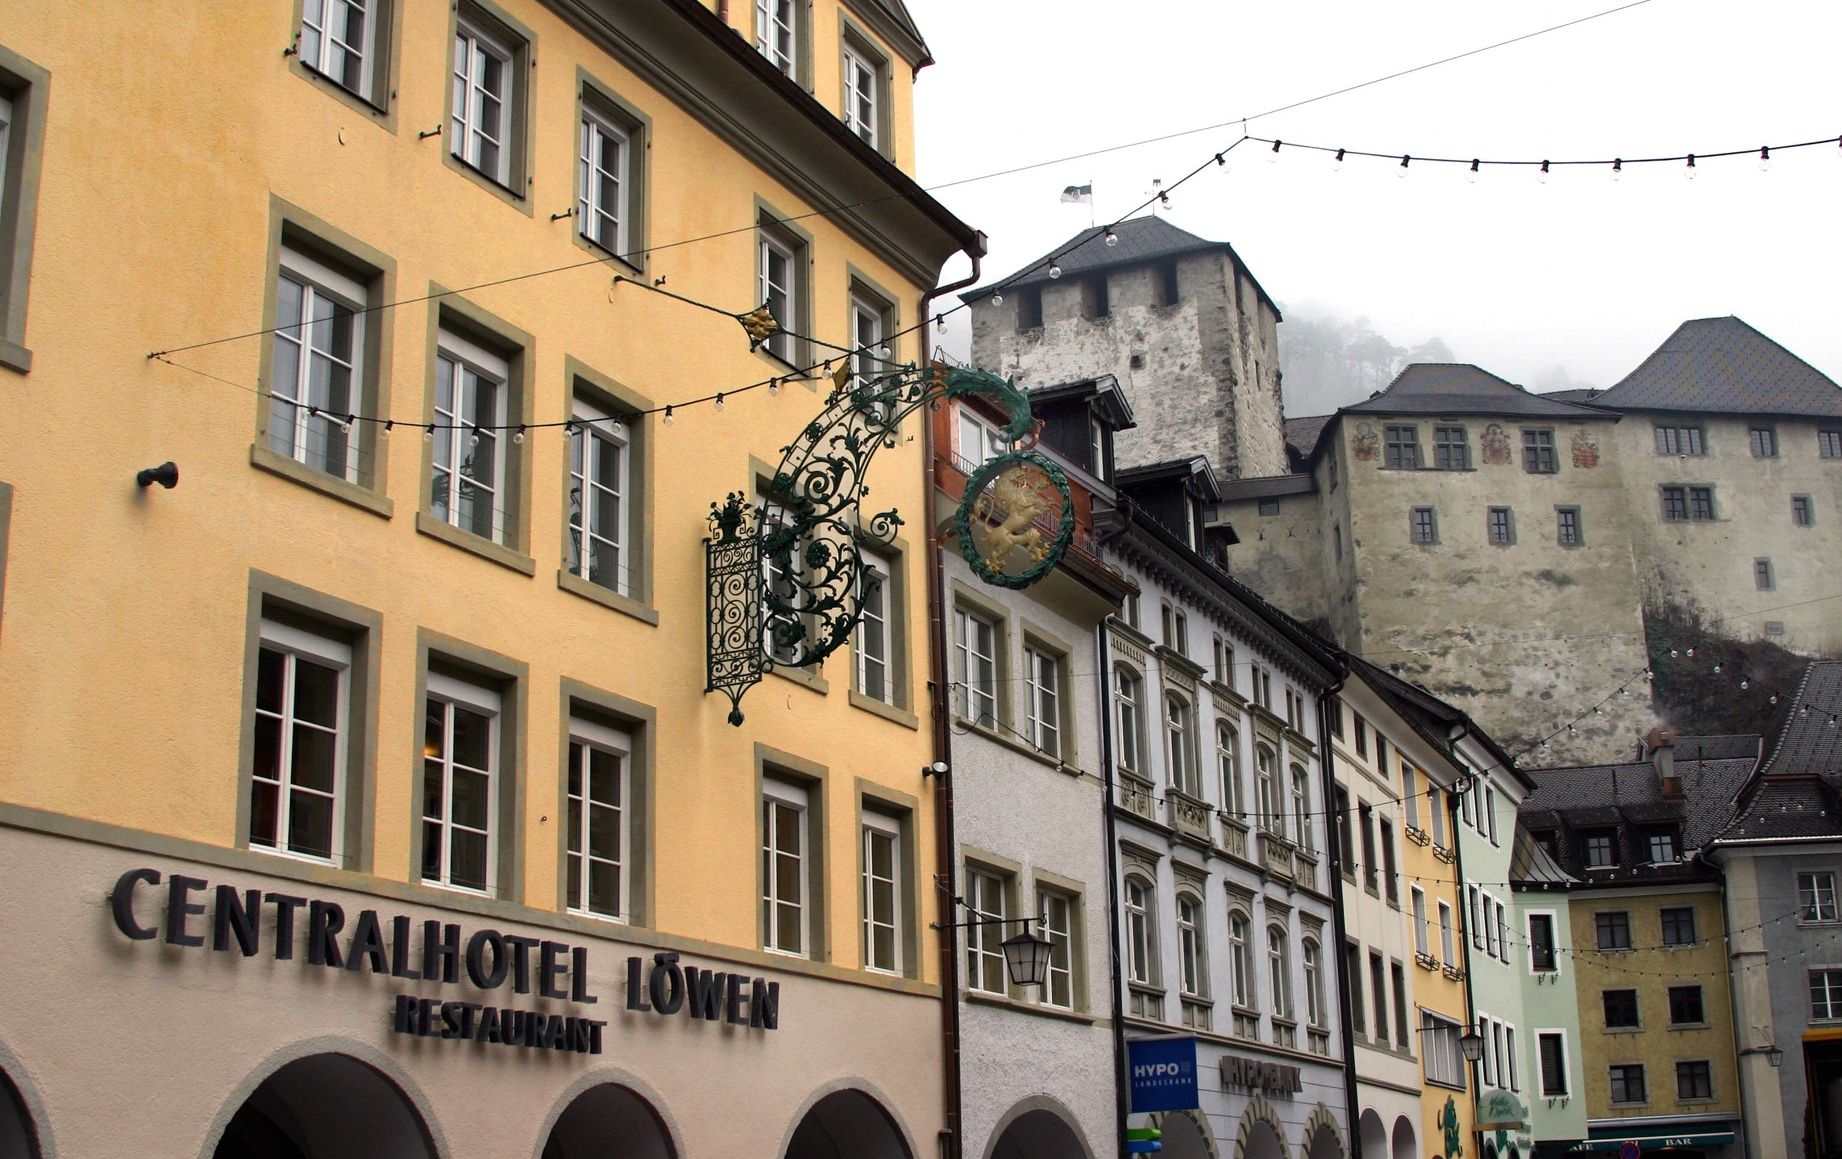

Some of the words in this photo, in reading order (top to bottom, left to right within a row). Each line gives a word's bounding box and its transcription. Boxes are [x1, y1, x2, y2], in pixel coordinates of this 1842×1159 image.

[110, 867, 598, 1004] CENTRALHOTEL
[625, 951, 780, 1030] LÖWEN
[394, 994, 608, 1055] RESTAURANT
[1134, 1062, 1180, 1078] HYPO
[1664, 1137, 1693, 1146] BAR
